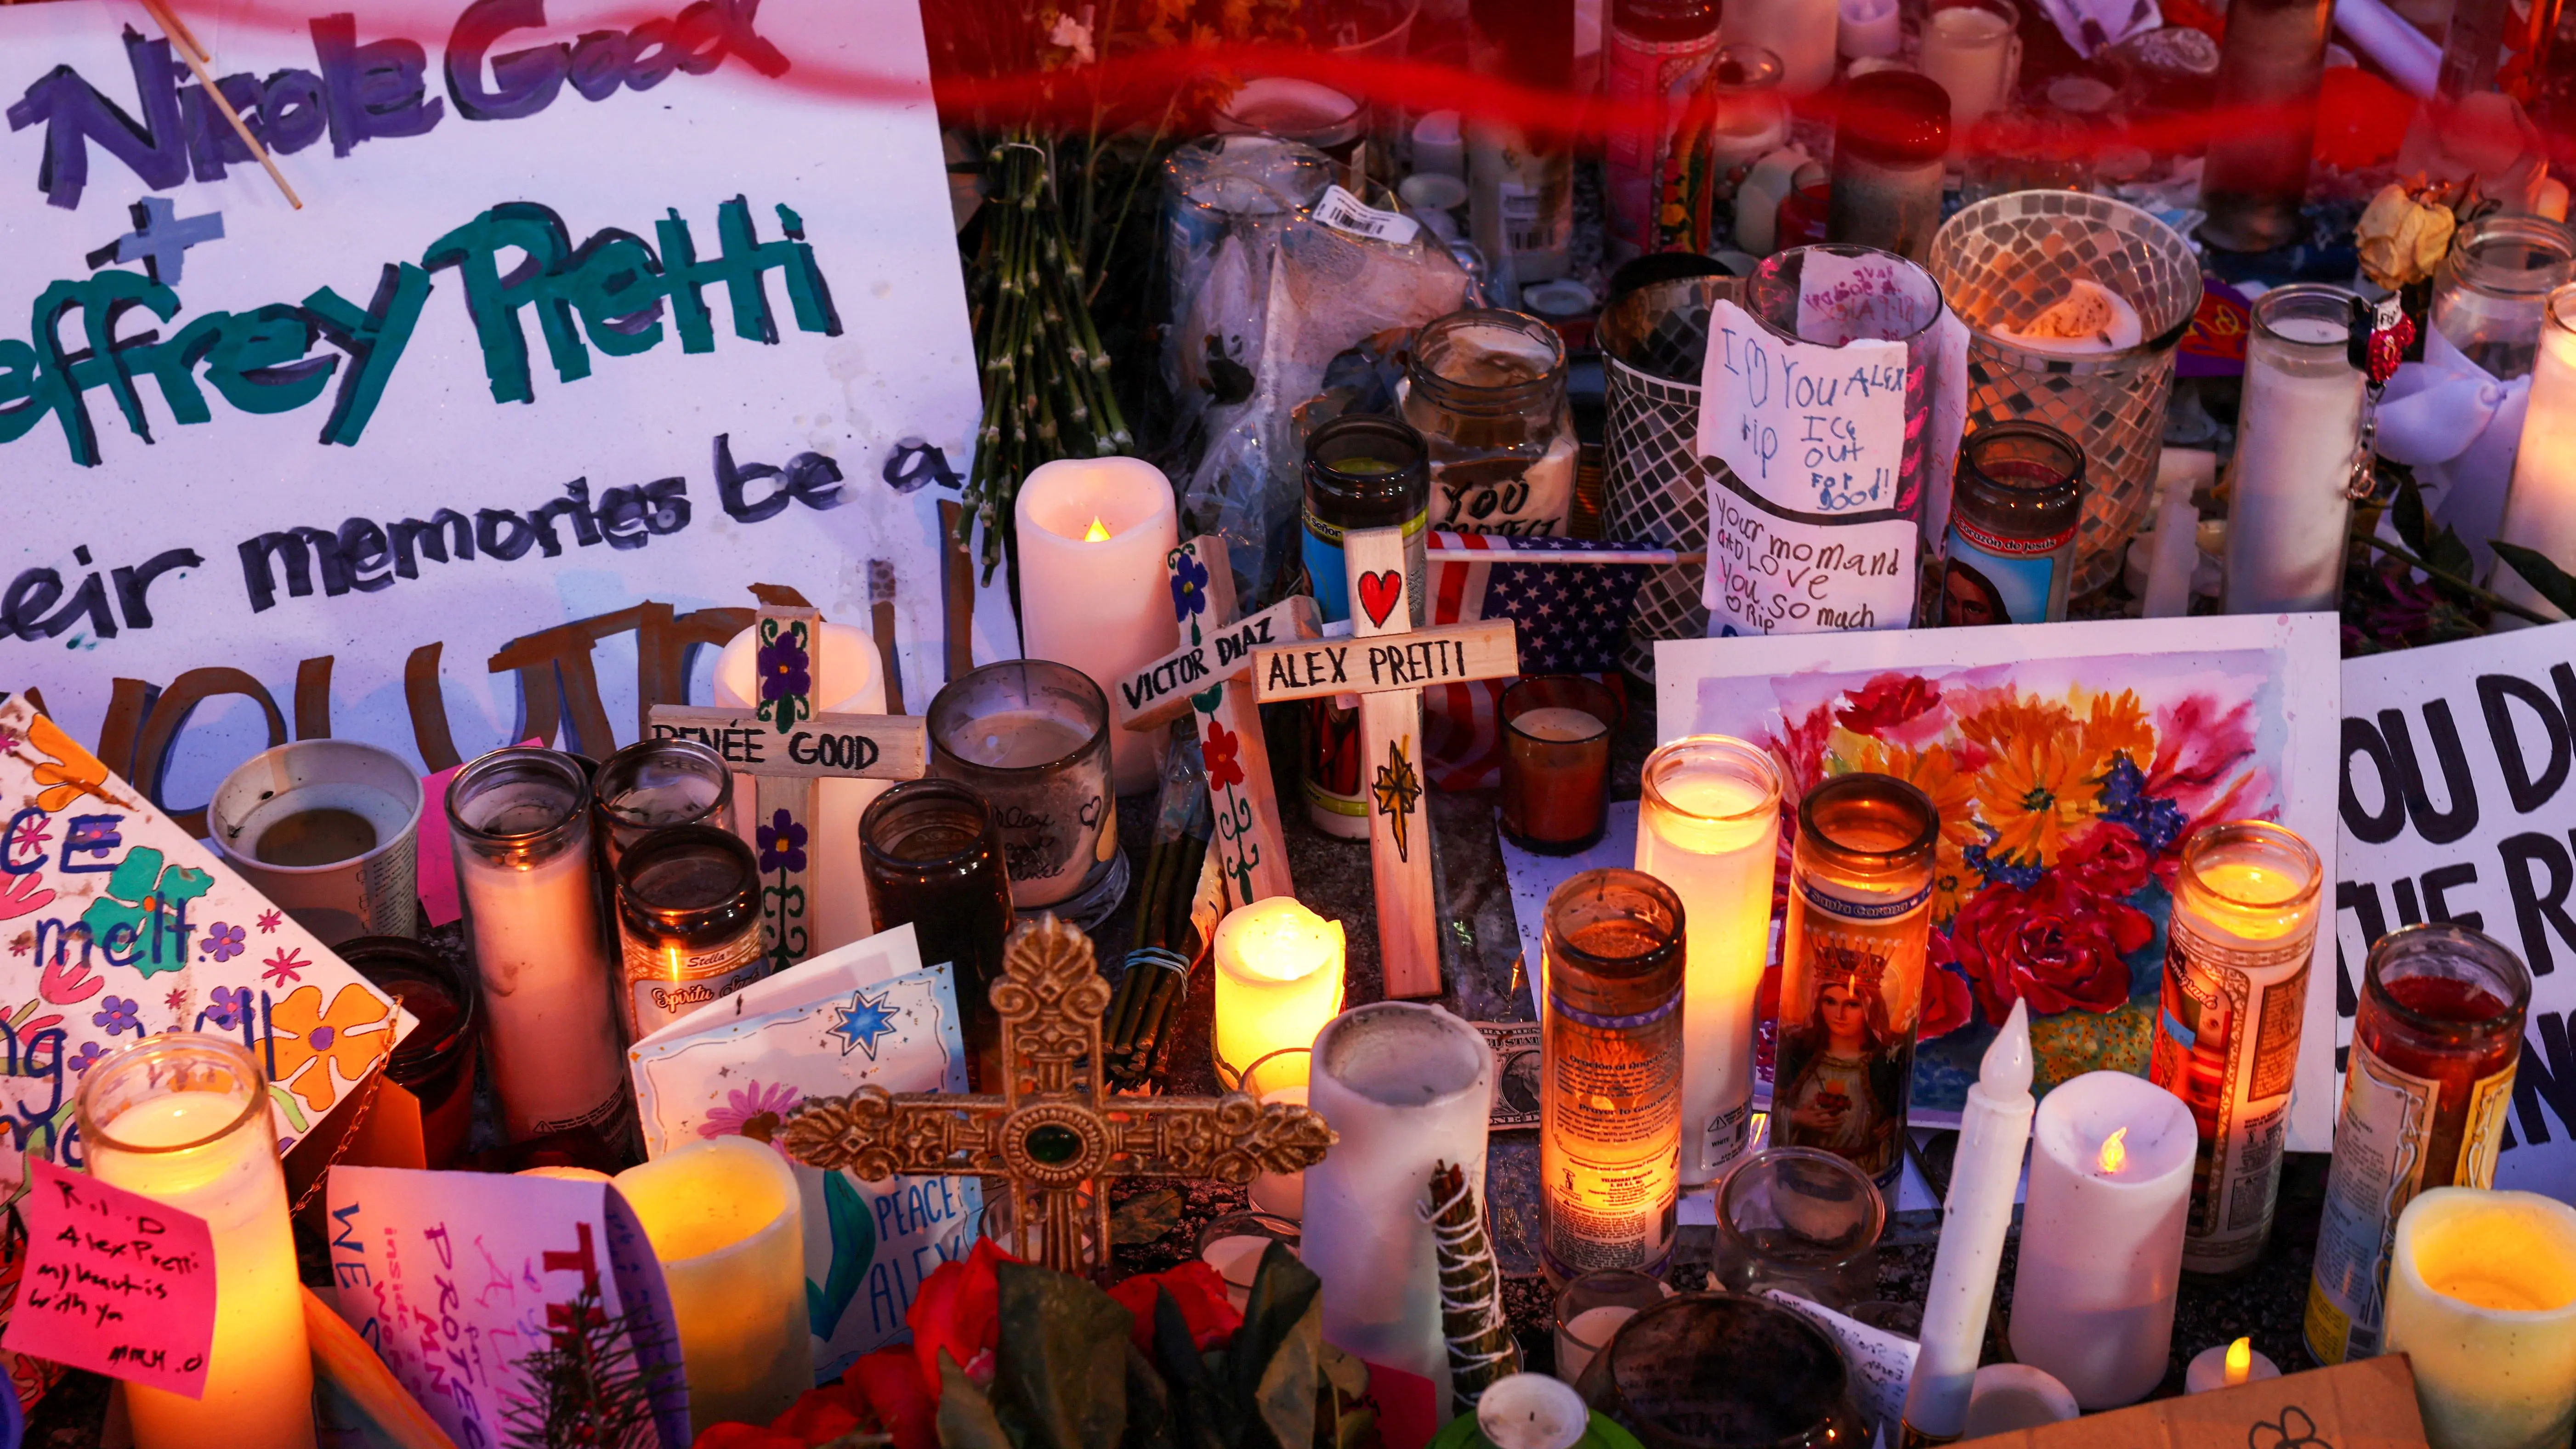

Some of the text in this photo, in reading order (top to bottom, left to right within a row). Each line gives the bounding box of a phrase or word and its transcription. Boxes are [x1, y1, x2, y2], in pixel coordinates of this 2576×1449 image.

[6, 13, 445, 210] Nicole
[420, 193, 843, 404] Pretti
[237, 476, 692, 614] memories
[712, 432, 844, 523] be
[882, 436, 965, 493] a
[1441, 481, 1529, 523] YOU
[2004, 540, 2021, 551] de
[1121, 616, 1276, 710] VICTOR DIAZ
[1268, 640, 1466, 692] ALEX PRETTI
[789, 731, 879, 770] GOOD
[687, 953, 726, 967] Stella
[1569, 1054, 1612, 1070] Oración
[1579, 1103, 1616, 1115] Prayer
[875, 1176, 956, 1241] PEACE
[331, 1201, 372, 1290] WE
